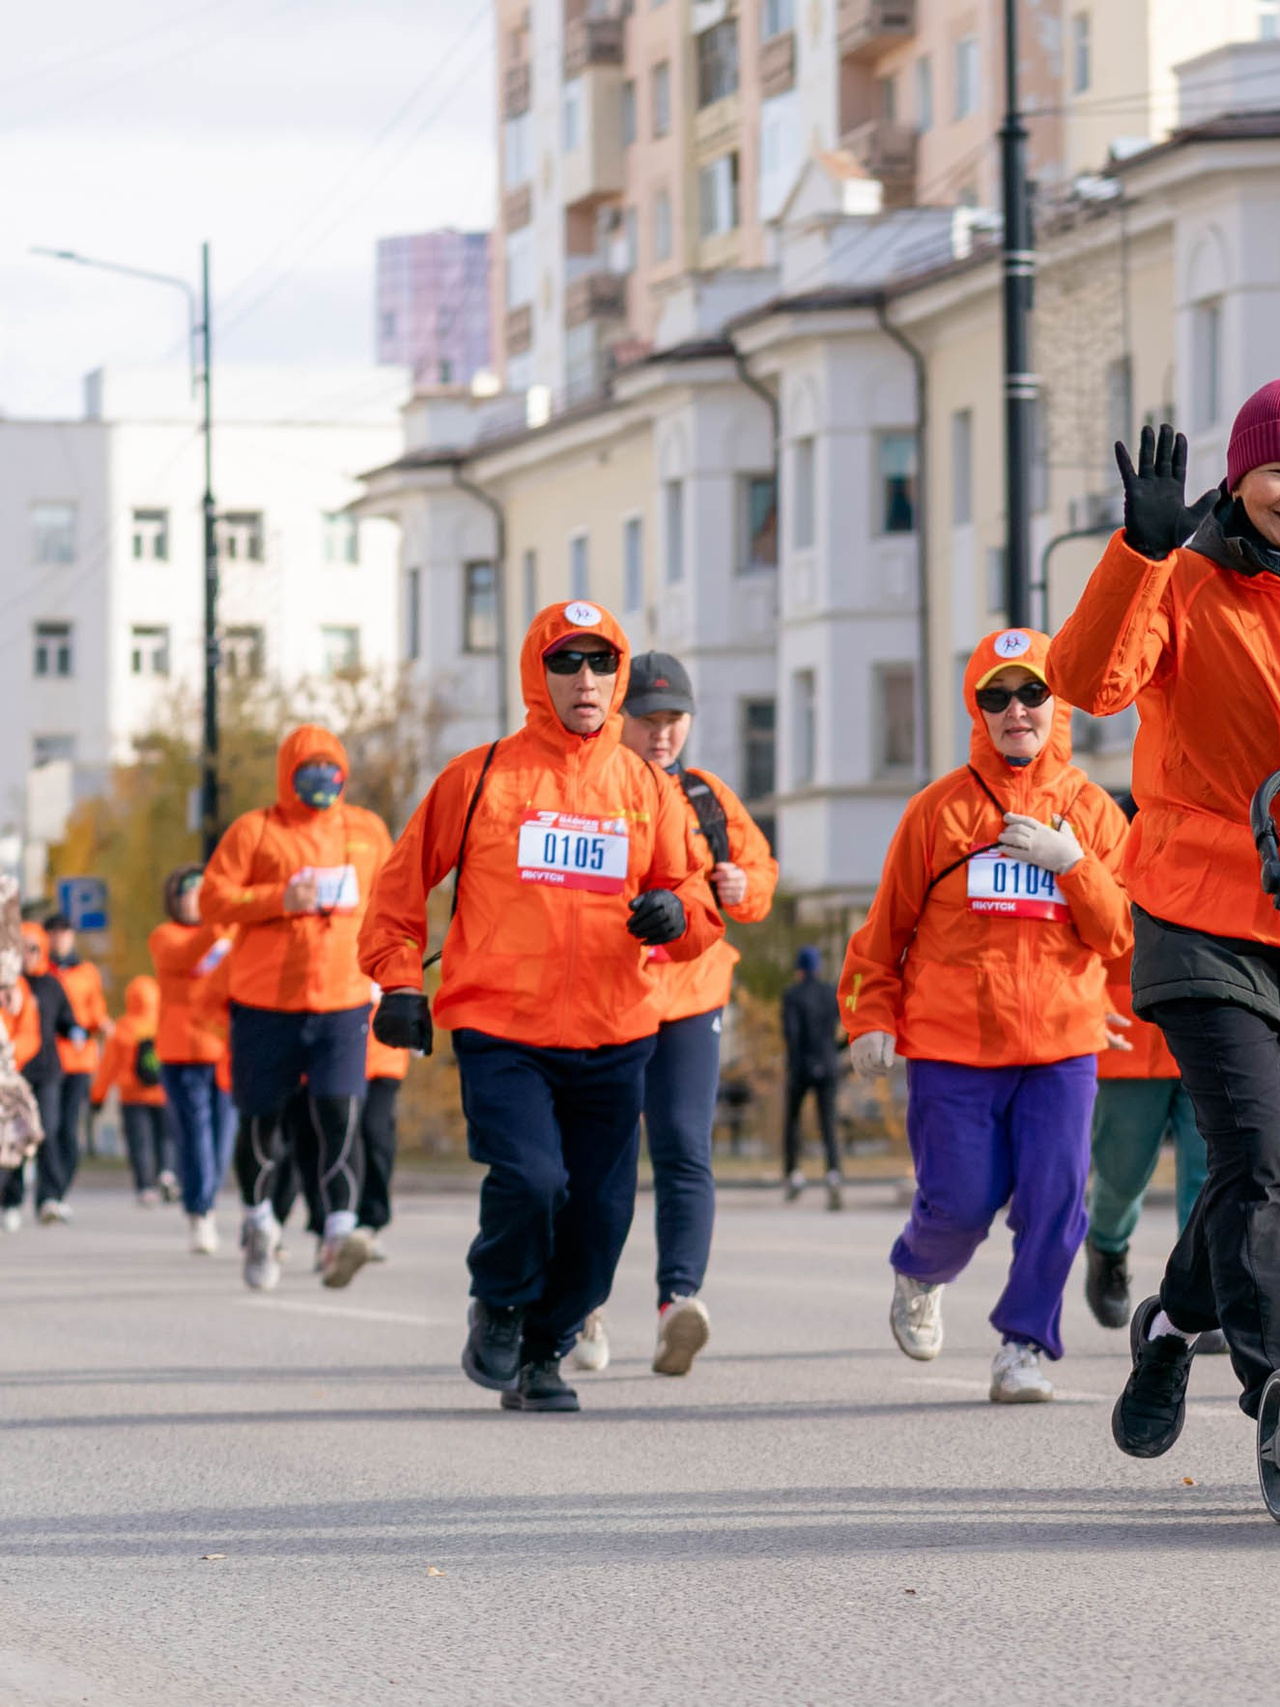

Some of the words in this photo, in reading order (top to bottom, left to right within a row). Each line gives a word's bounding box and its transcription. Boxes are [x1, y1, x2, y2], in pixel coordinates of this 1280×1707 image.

[544, 833, 605, 870] 0105
[993, 862, 1056, 897] 0104
[971, 901, 1017, 912] ЯКУТСК
